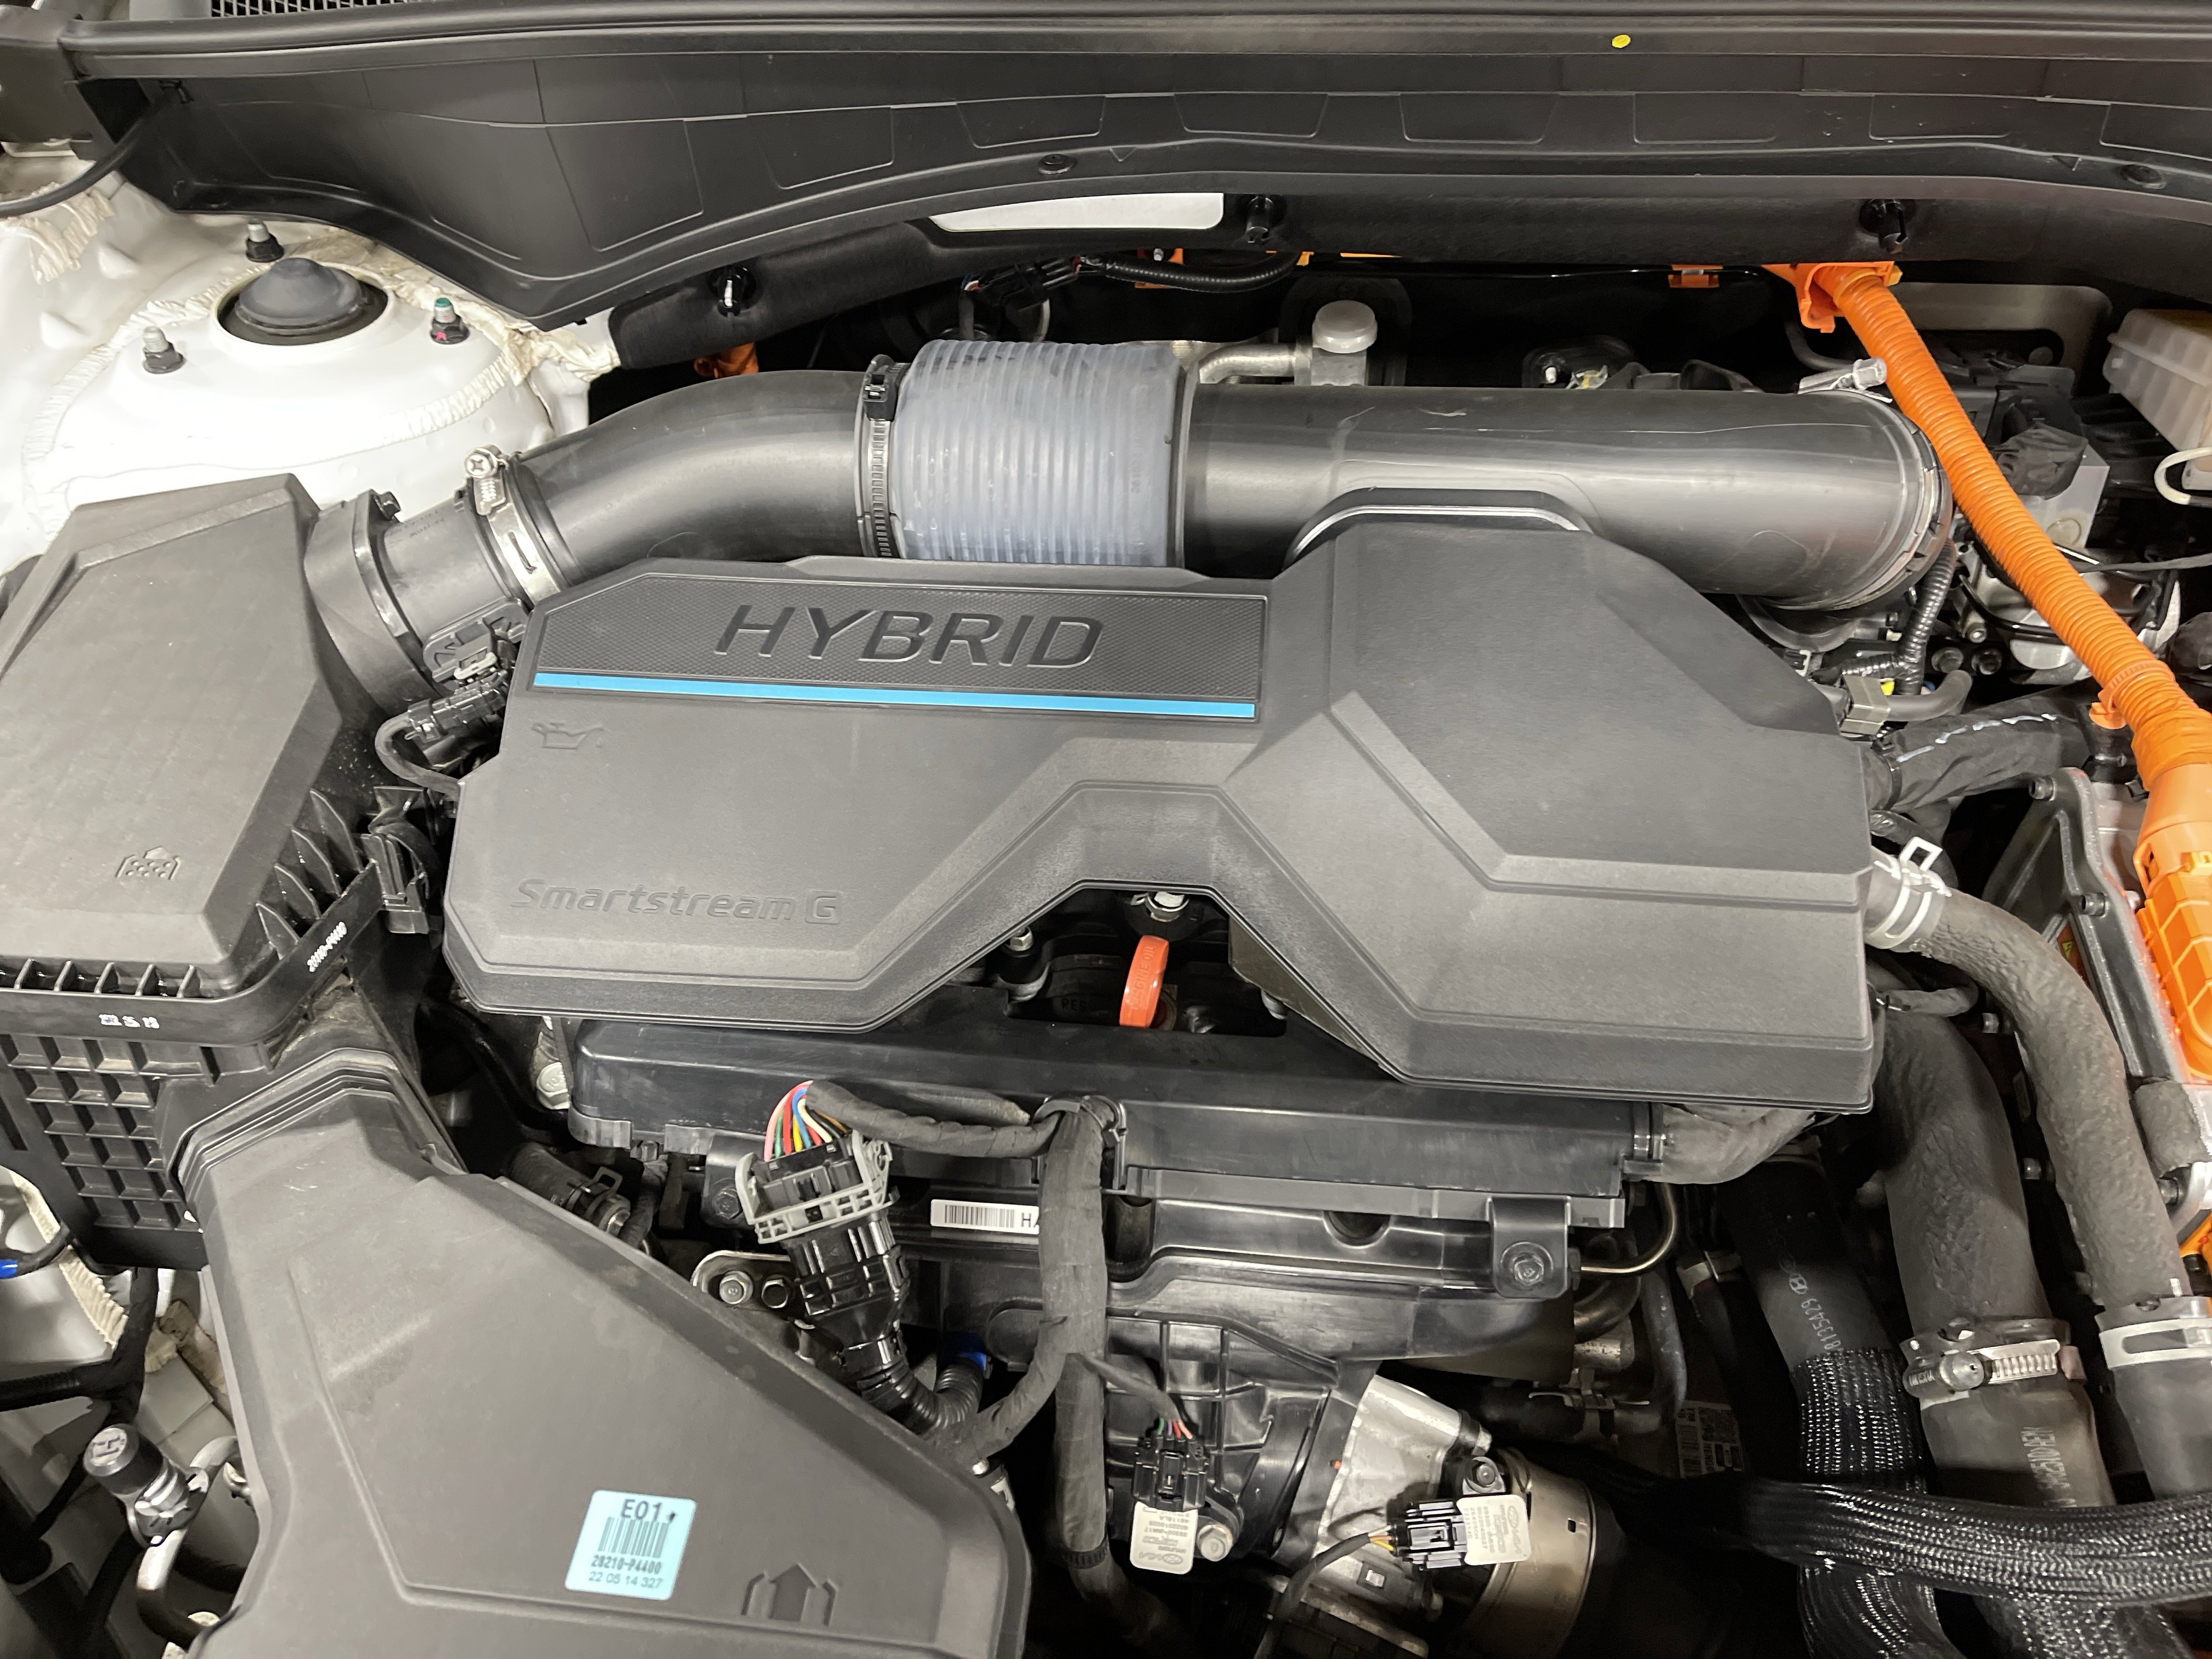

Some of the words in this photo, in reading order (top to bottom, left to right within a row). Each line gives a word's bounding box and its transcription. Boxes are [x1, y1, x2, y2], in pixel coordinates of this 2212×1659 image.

[714, 604, 1104, 669] HYBRID
[510, 878, 798, 921] Smartstream
[808, 892, 842, 923] G
[1142, 945, 1156, 963] OIL
[620, 1498, 663, 1522] E01
[591, 1554, 663, 1575] 28210-P4400
[589, 1571, 603, 1582] 22
[606, 1573, 621, 1584] 05
[625, 1576, 638, 1585] 14
[641, 1577, 663, 1589] 327
